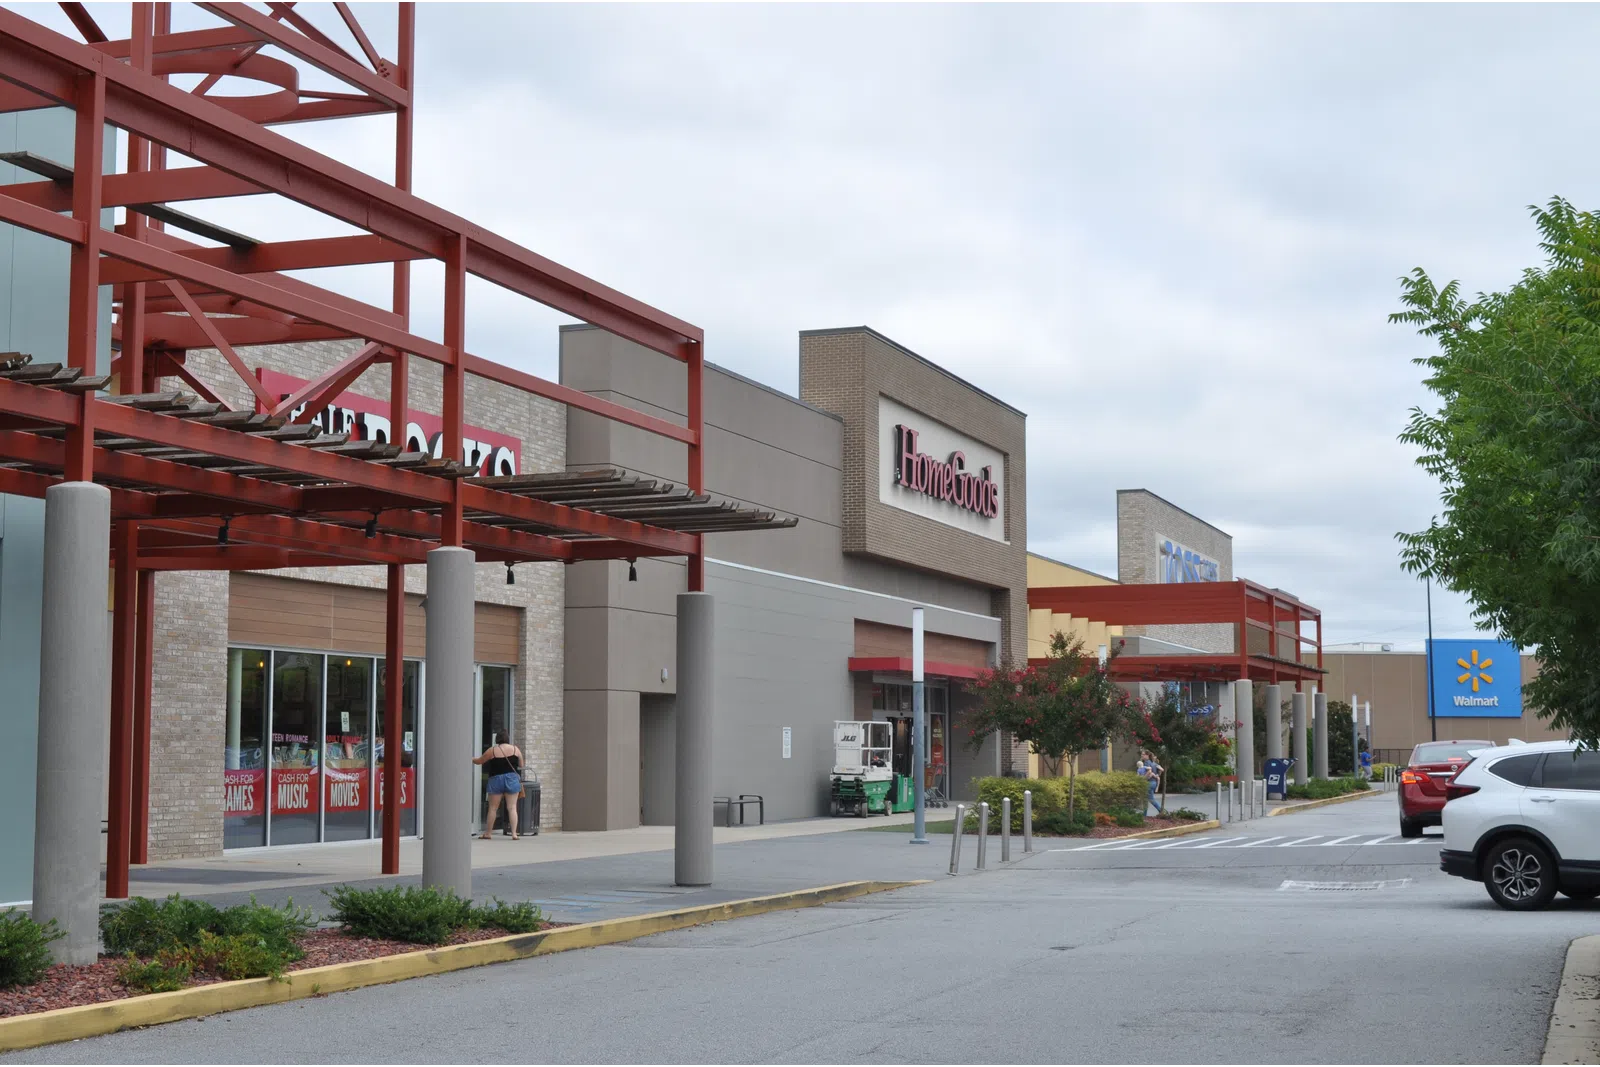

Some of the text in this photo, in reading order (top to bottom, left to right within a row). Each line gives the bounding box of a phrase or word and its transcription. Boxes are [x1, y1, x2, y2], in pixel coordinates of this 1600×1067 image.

[358, 411, 517, 478] BOKS
[895, 424, 999, 519] HomeGoods
[1453, 695, 1499, 707] Walmart
[225, 774, 254, 785] ASH FOR
[277, 773, 309, 783] CASH FOR
[277, 783, 309, 810] MUSIC
[330, 782, 360, 808] MOVIES
